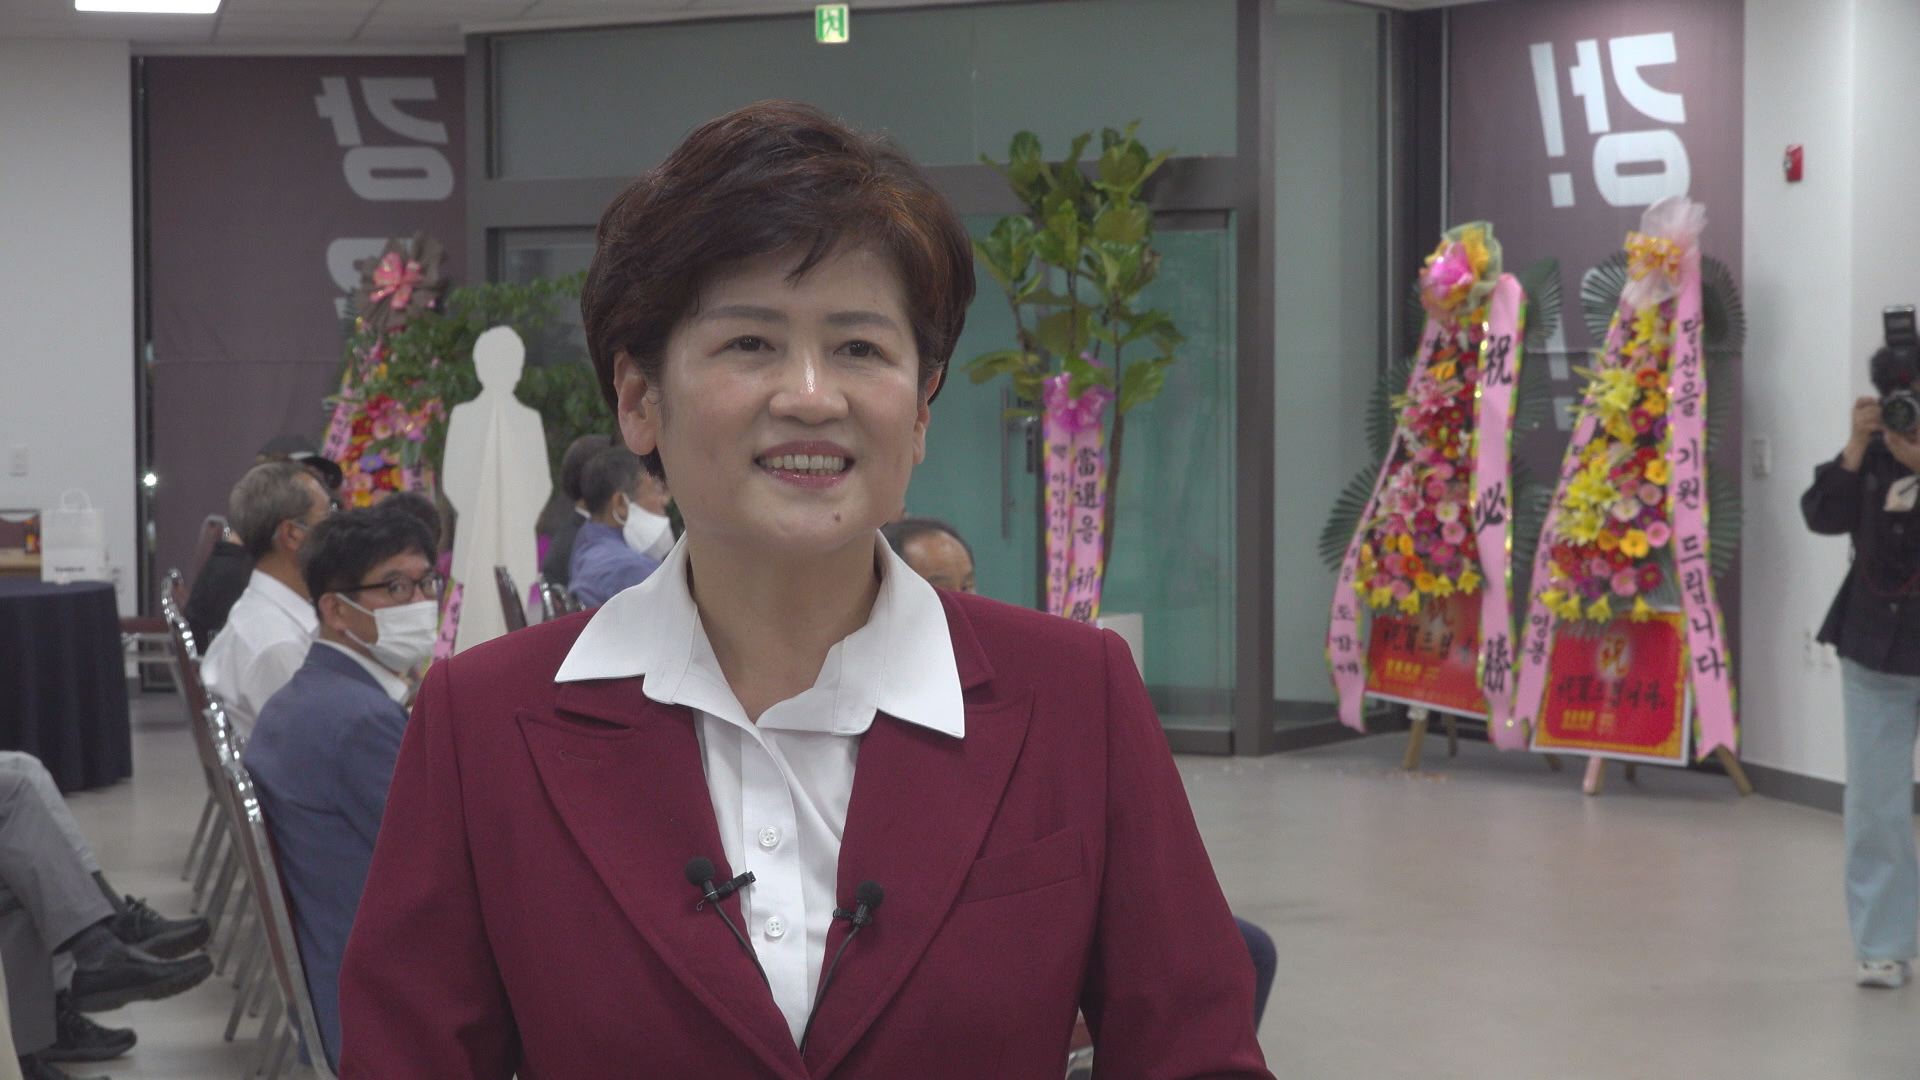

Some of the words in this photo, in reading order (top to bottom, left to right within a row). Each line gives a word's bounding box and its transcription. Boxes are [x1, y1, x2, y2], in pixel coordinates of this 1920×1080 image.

[1676, 312, 1700, 417] 당선을
[1676, 437, 1700, 510] 기원
[1679, 534, 1727, 681] 드립니다
